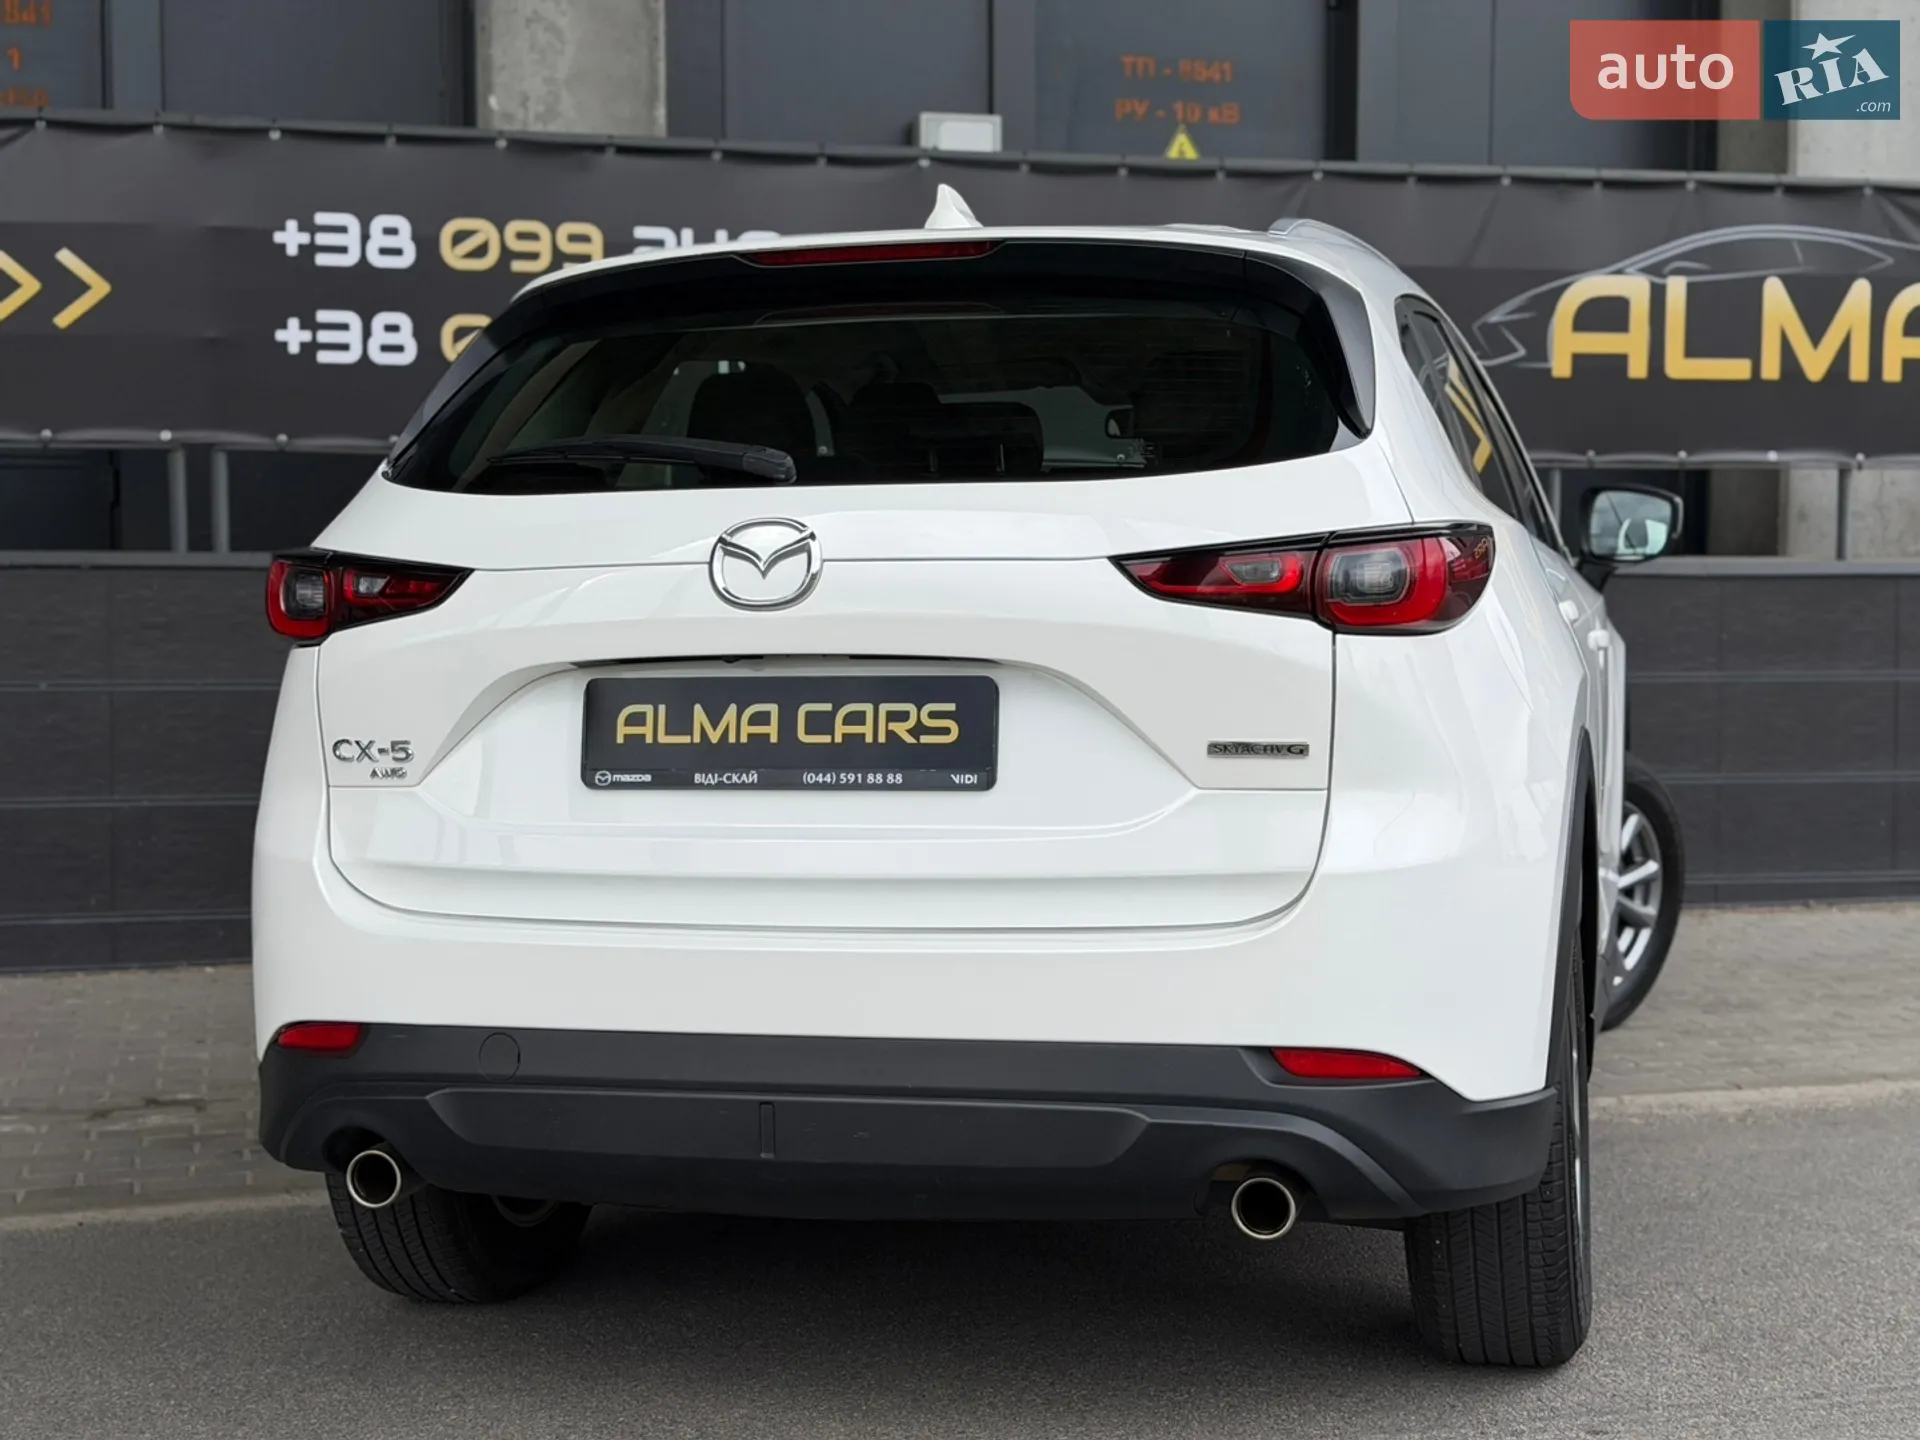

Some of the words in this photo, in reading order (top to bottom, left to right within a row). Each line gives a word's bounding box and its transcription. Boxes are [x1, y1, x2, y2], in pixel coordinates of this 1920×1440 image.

[273, 211, 417, 269] +38
[439, 217, 604, 273] 099
[274, 309, 418, 366] +38
[616, 702, 779, 744] ALMA
[797, 702, 959, 744] CARS
[332, 739, 415, 763] CX-5
[612, 773, 652, 783] mazda
[694, 770, 758, 786] ВІДІ-СКАЙ
[803, 771, 836, 785] (044)
[839, 772, 862, 785] 591
[866, 772, 883, 784] 88
[886, 772, 903, 784] 88
[950, 773, 978, 785] VIDI
